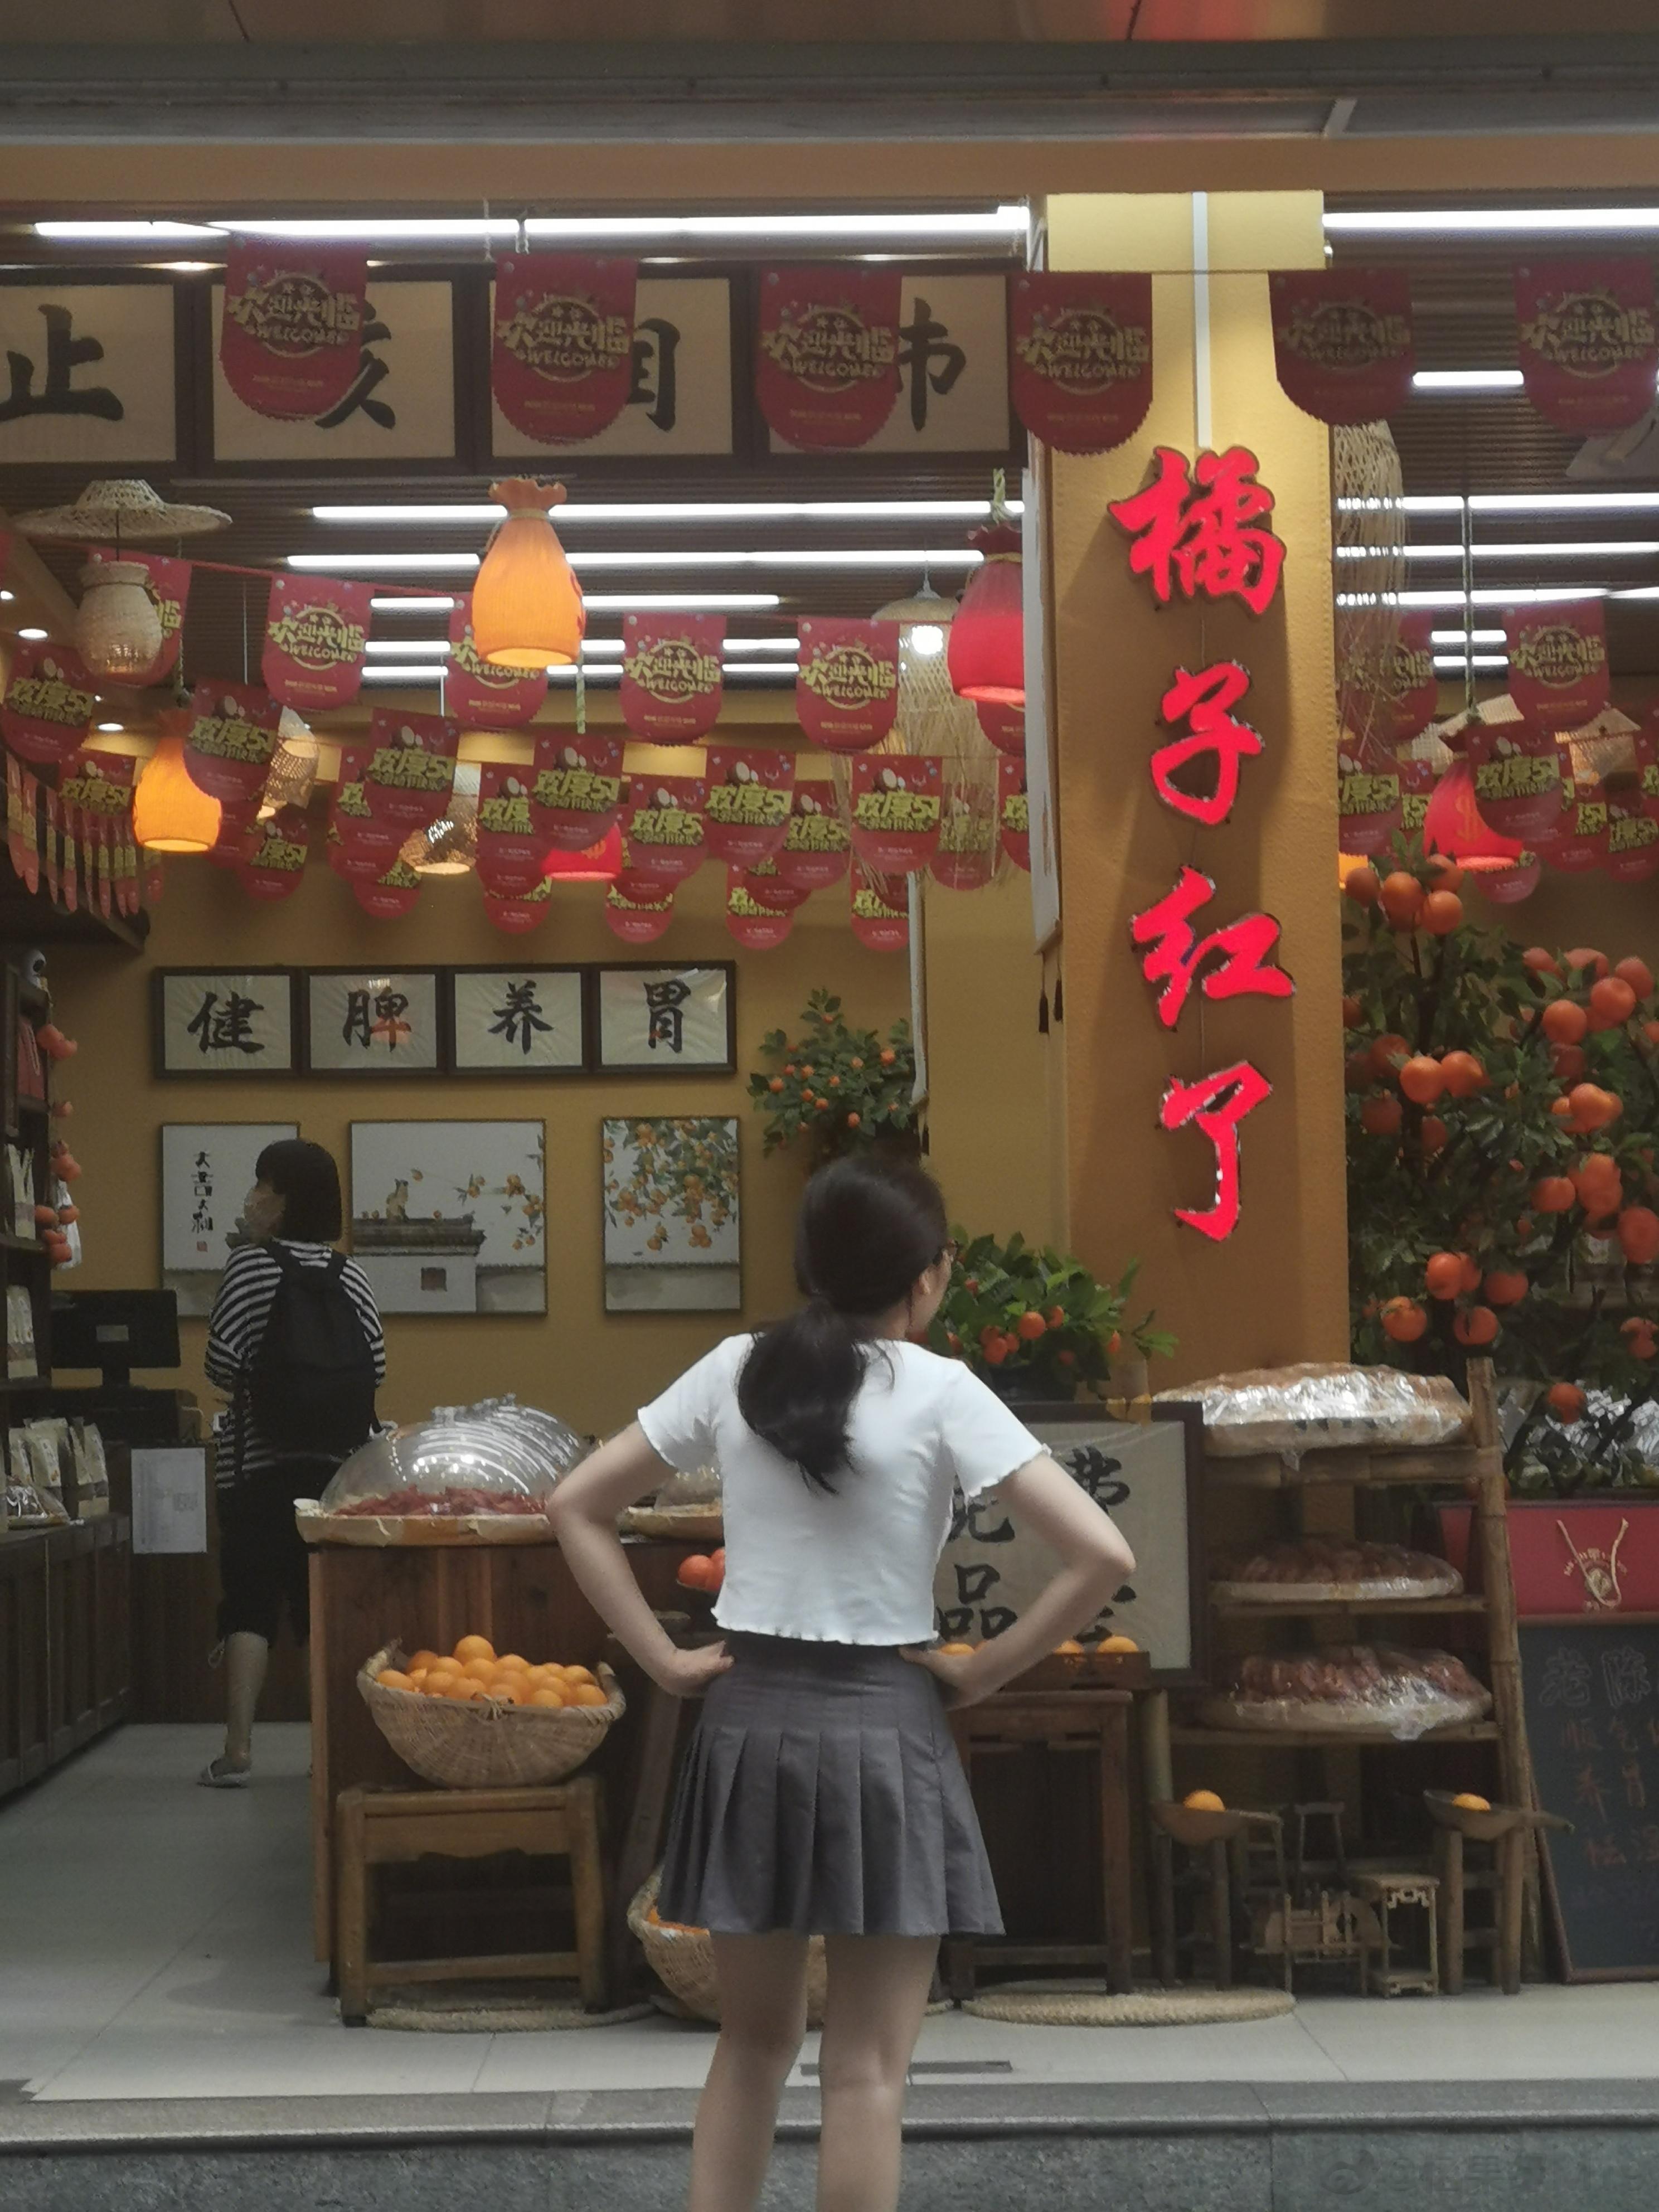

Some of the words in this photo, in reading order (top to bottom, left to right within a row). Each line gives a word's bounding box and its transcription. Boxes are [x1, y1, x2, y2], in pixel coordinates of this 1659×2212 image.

[187, 979, 692, 1054] 健脾养胃
[1109, 446, 1296, 1241] 橘子红了
